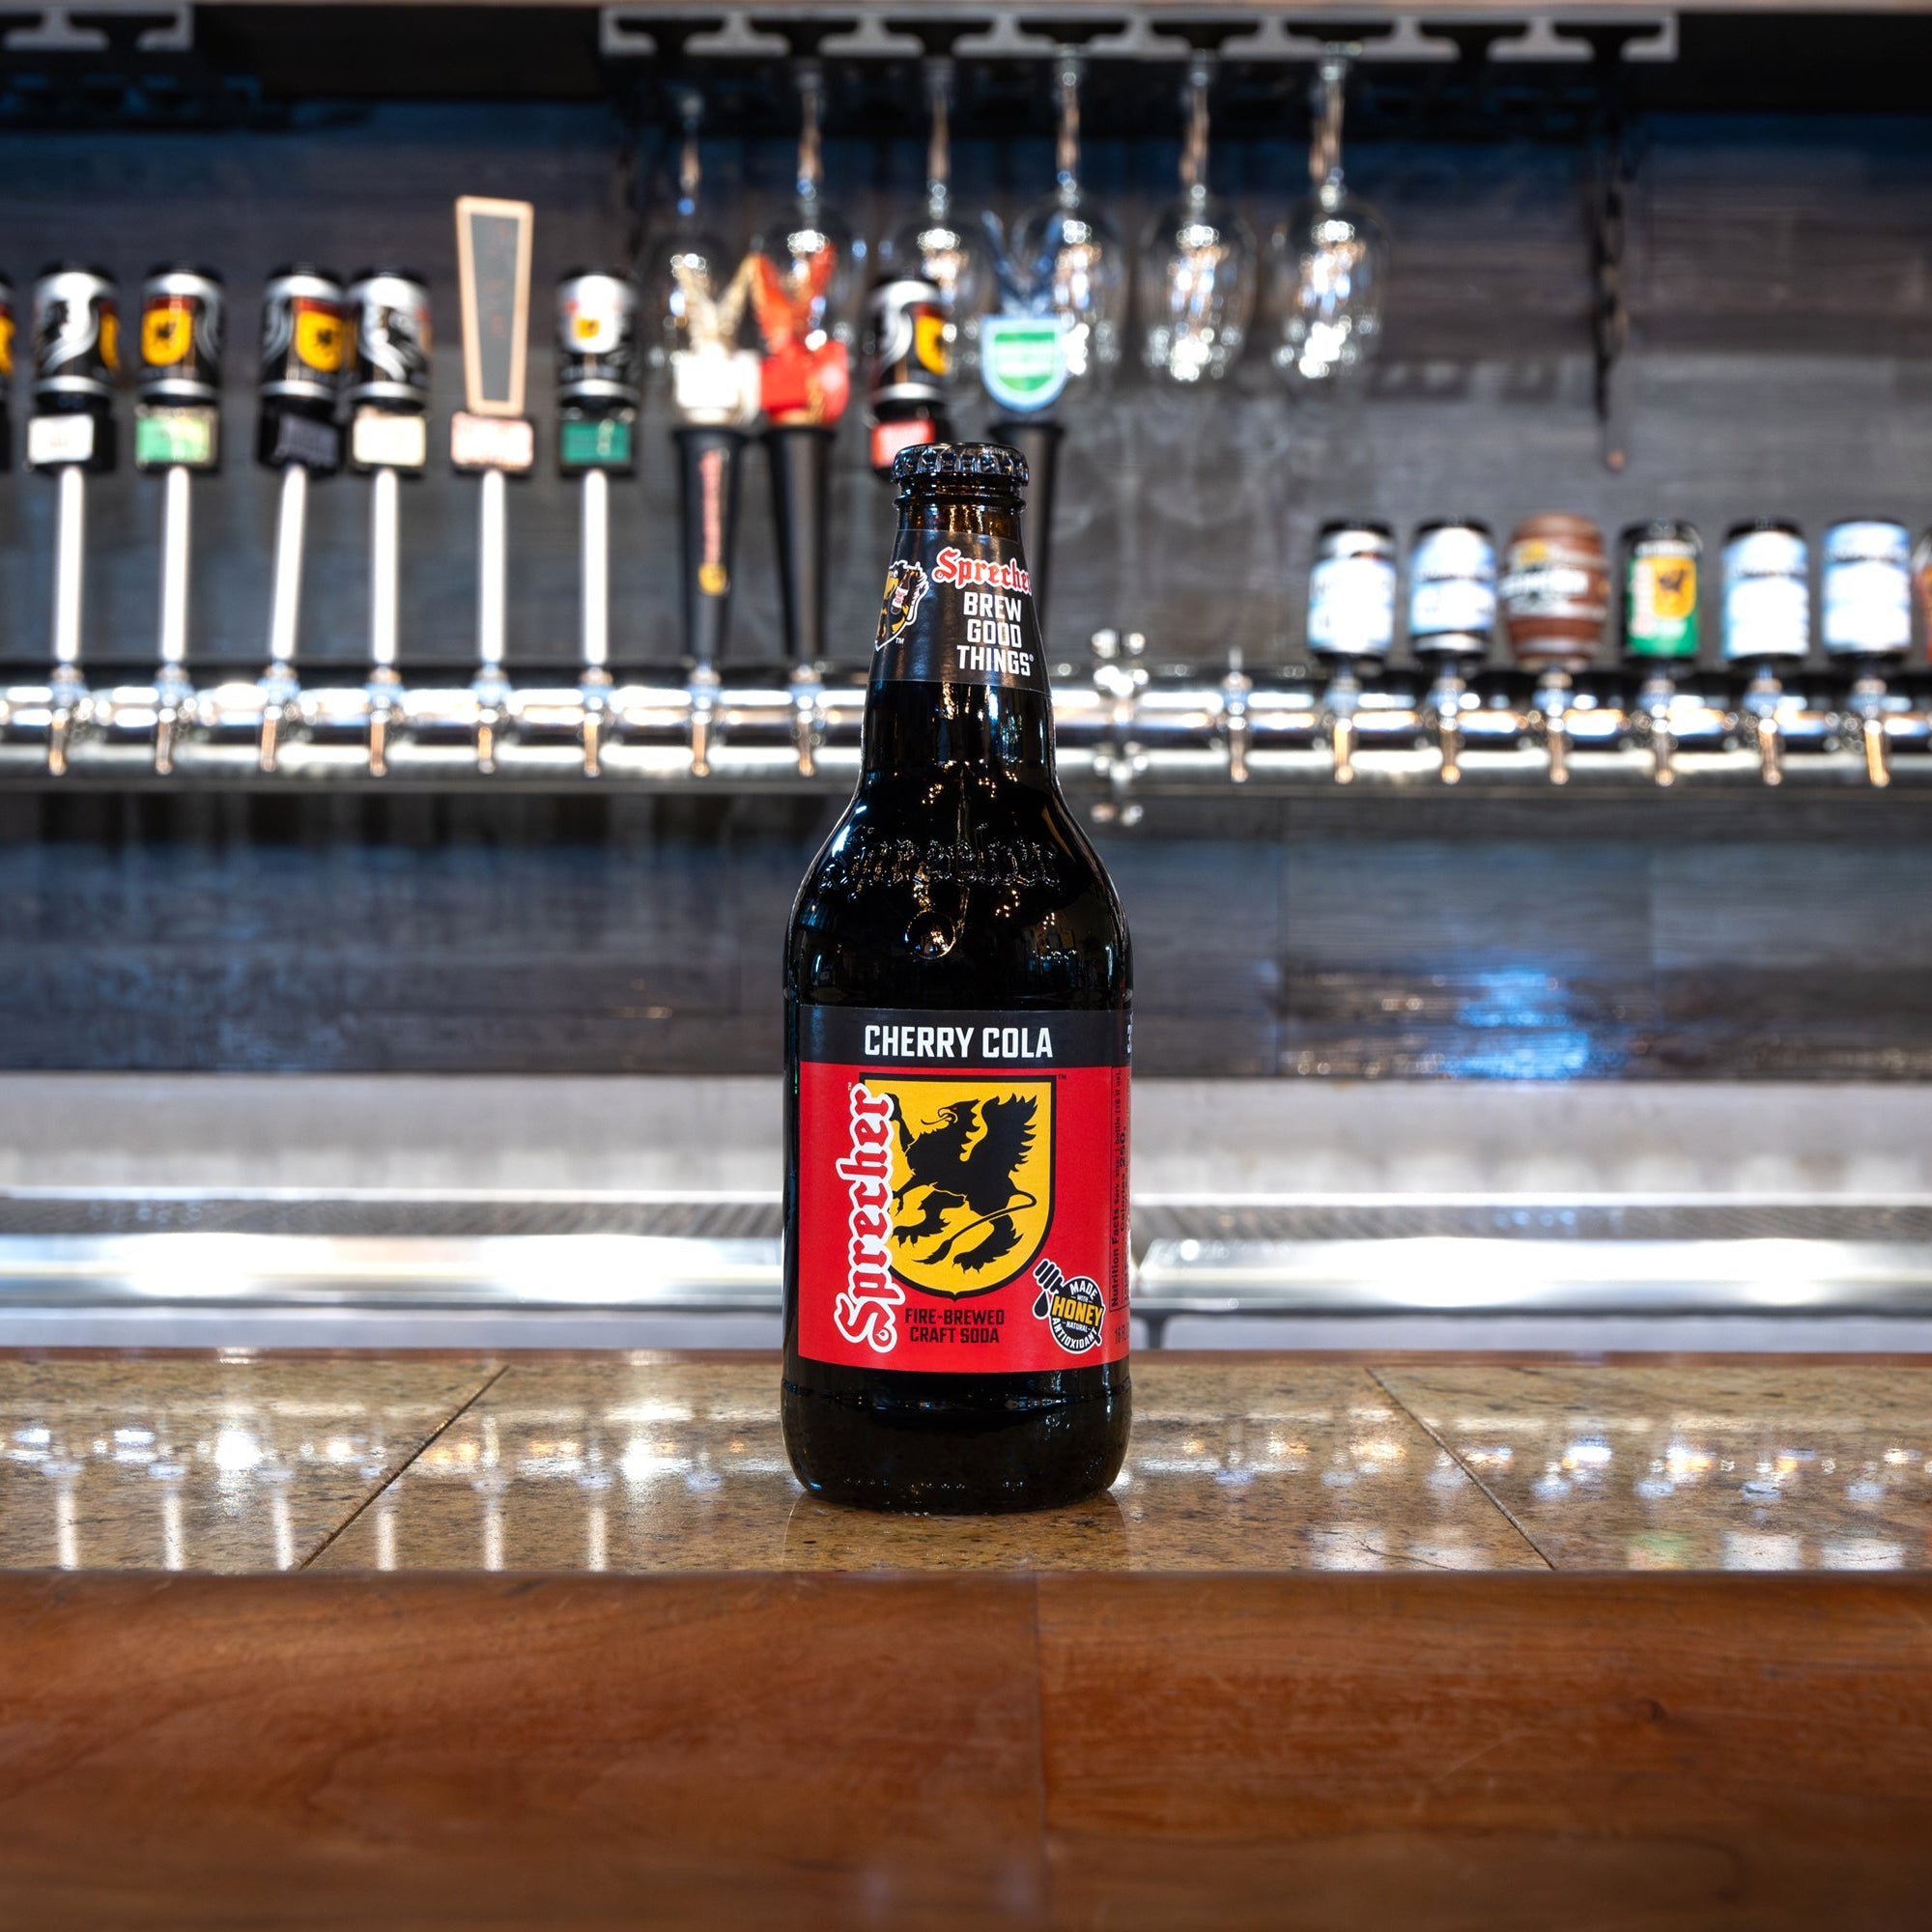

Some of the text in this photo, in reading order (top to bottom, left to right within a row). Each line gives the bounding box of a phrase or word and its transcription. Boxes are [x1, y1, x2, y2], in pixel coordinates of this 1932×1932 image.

[963, 591, 1022, 622] BREW
[967, 618, 1022, 648] GOOD
[865, 1024, 1053, 1059] CHERRY COLA
[835, 1083, 906, 1352] Sprecher
[1069, 1280, 1098, 1300] MADE
[905, 1308, 1005, 1325] FIRE-BREWED
[1051, 1296, 1103, 1326] HONEY
[909, 1326, 1000, 1344] CRAFT SODA
[1051, 1317, 1098, 1350] ANTIOXIDANT
[1065, 1321, 1089, 1332] NATURAL
